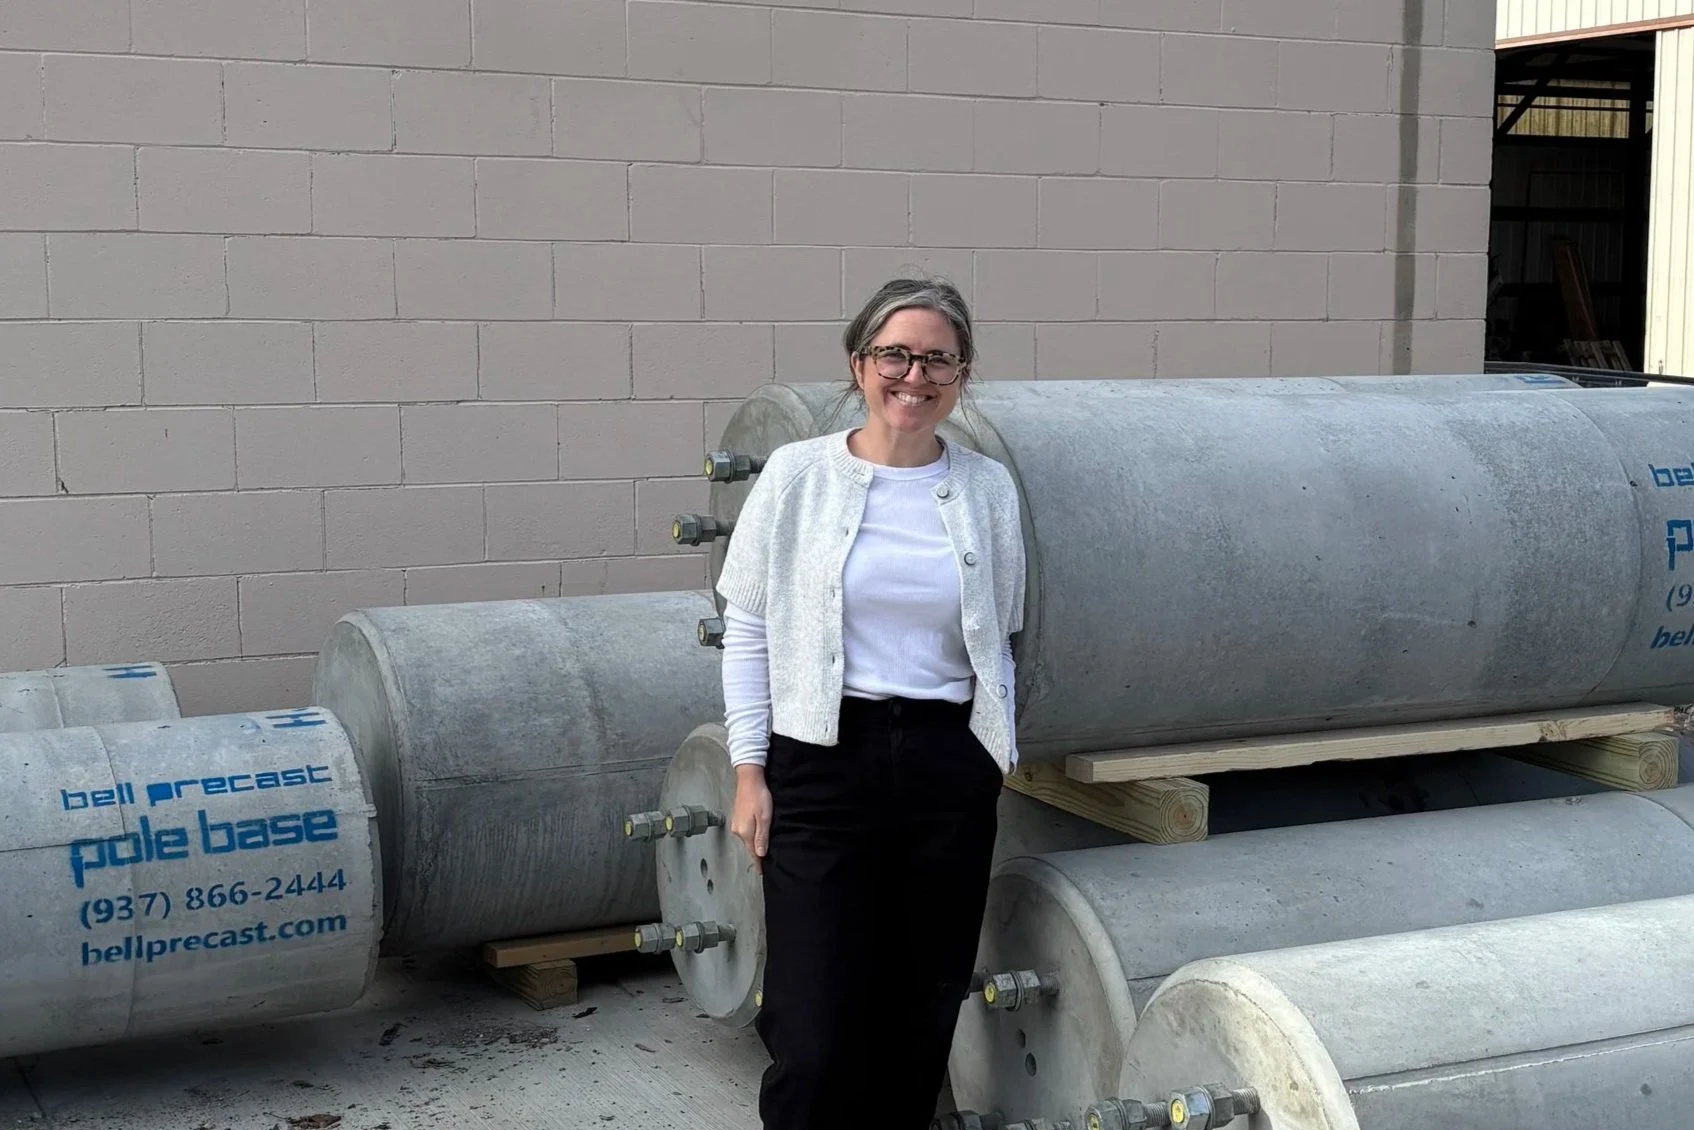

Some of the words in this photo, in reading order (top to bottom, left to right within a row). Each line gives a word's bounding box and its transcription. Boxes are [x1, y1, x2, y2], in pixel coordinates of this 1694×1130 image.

[60, 782, 135, 811] bell
[146, 765, 331, 807] precast
[68, 815, 189, 888] pole
[198, 809, 338, 854] base
[80, 891, 171, 930] (937)
[186, 868, 347, 911] 866-2444
[81, 913, 347, 966] bellprecast.com
